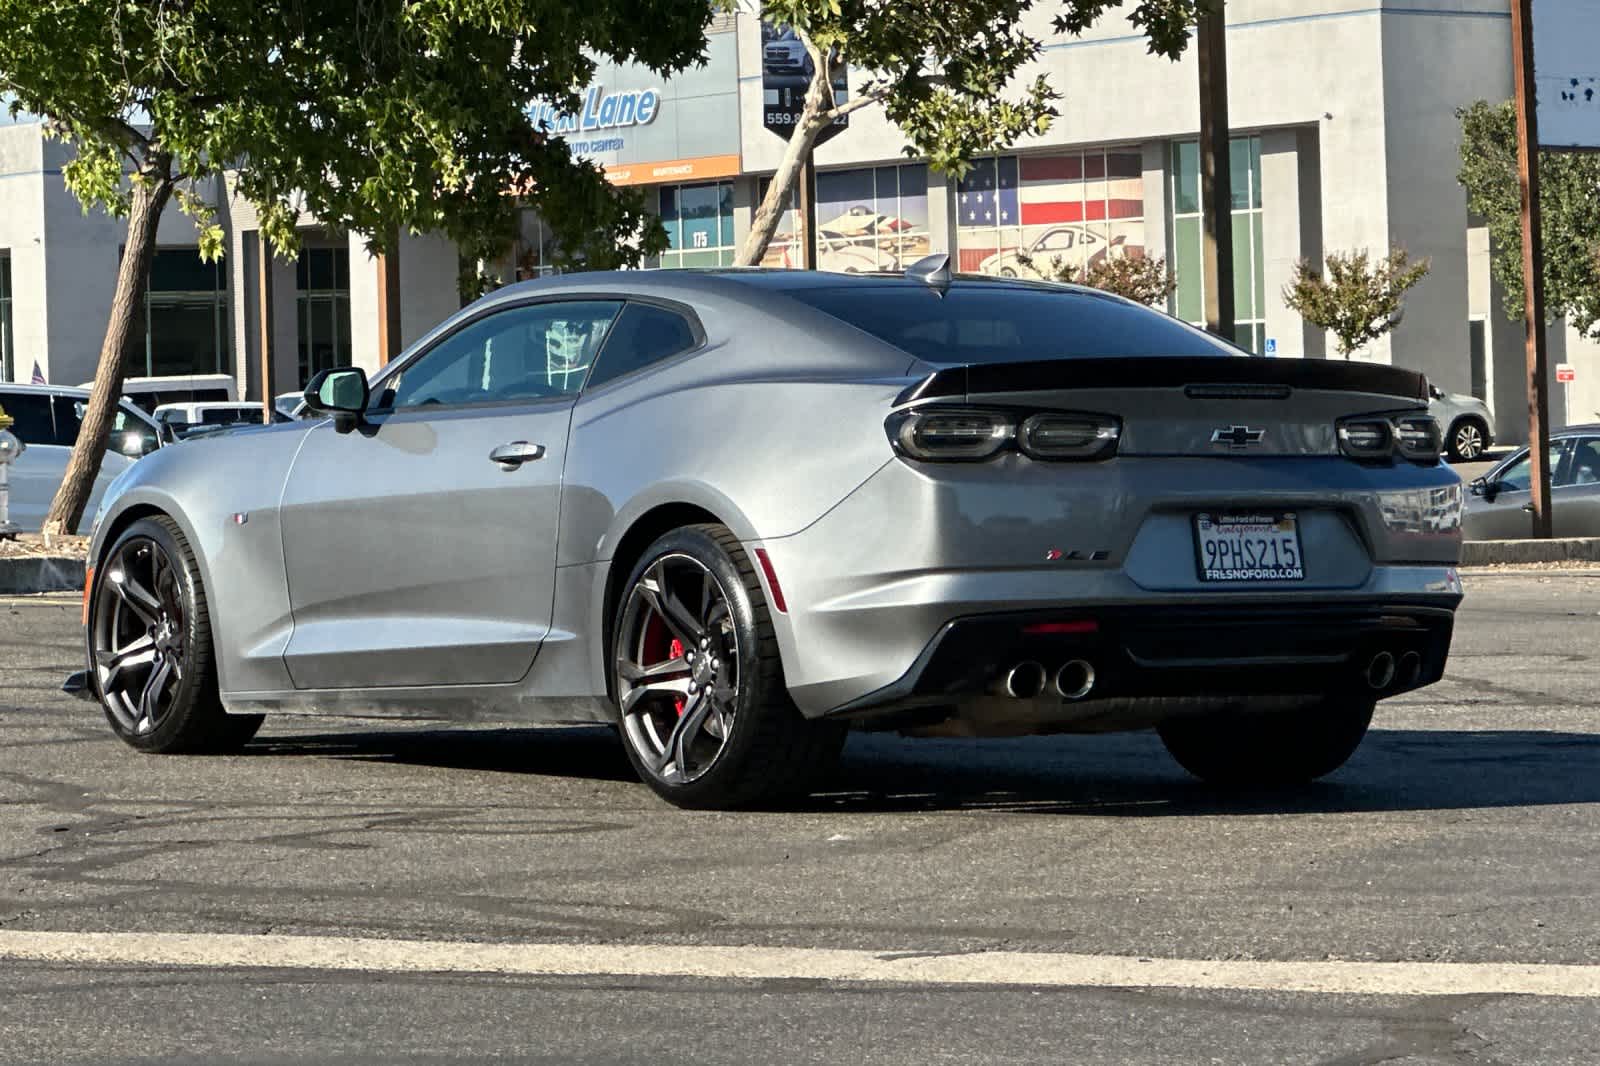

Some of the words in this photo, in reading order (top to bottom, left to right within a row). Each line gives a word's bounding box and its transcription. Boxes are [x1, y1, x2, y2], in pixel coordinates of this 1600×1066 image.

[582, 85, 657, 130] Lane
[1205, 538, 1296, 569] 9PHS215
[1206, 568, 1303, 580] FRESNOFORD.COM
